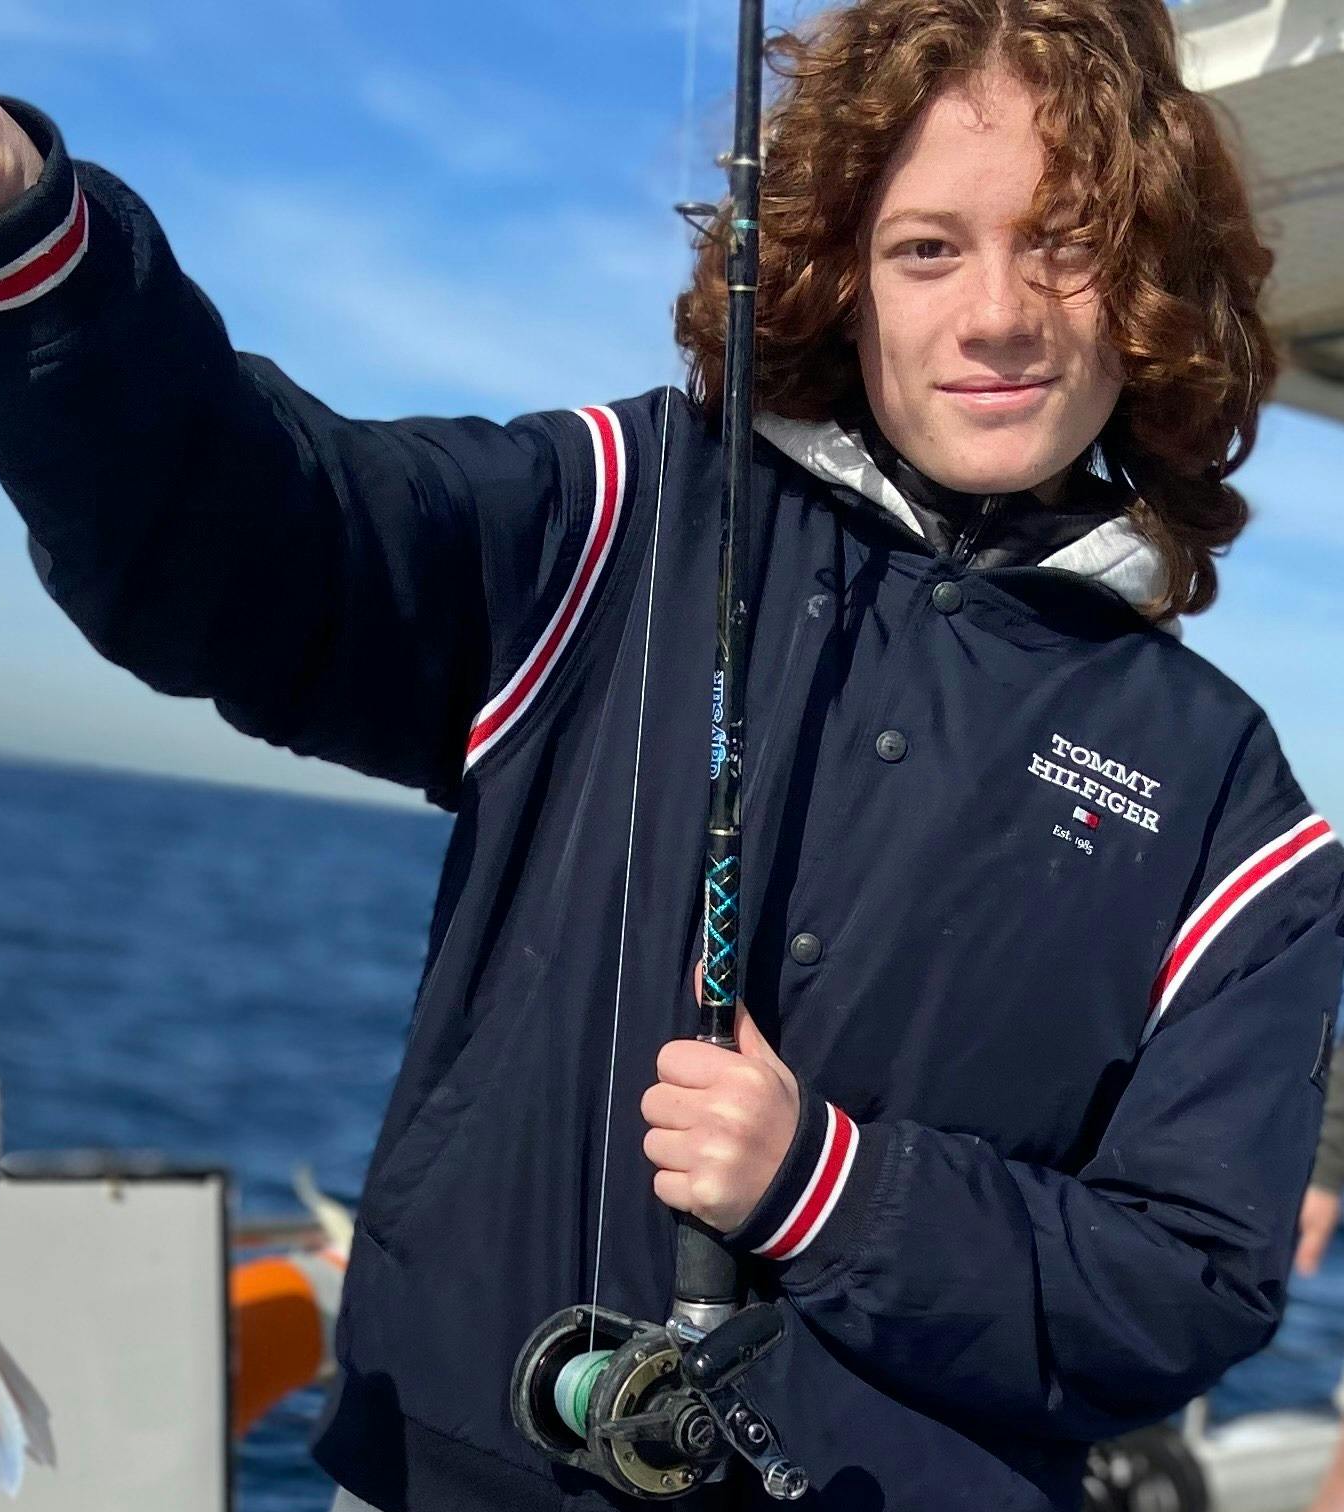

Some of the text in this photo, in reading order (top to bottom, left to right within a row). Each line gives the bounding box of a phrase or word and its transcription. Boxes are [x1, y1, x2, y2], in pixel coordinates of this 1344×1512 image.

[1027, 752, 1161, 833] HILFIGER
[1052, 733, 1161, 799] TOMMY
[1052, 824, 1093, 856] Est. 1985
